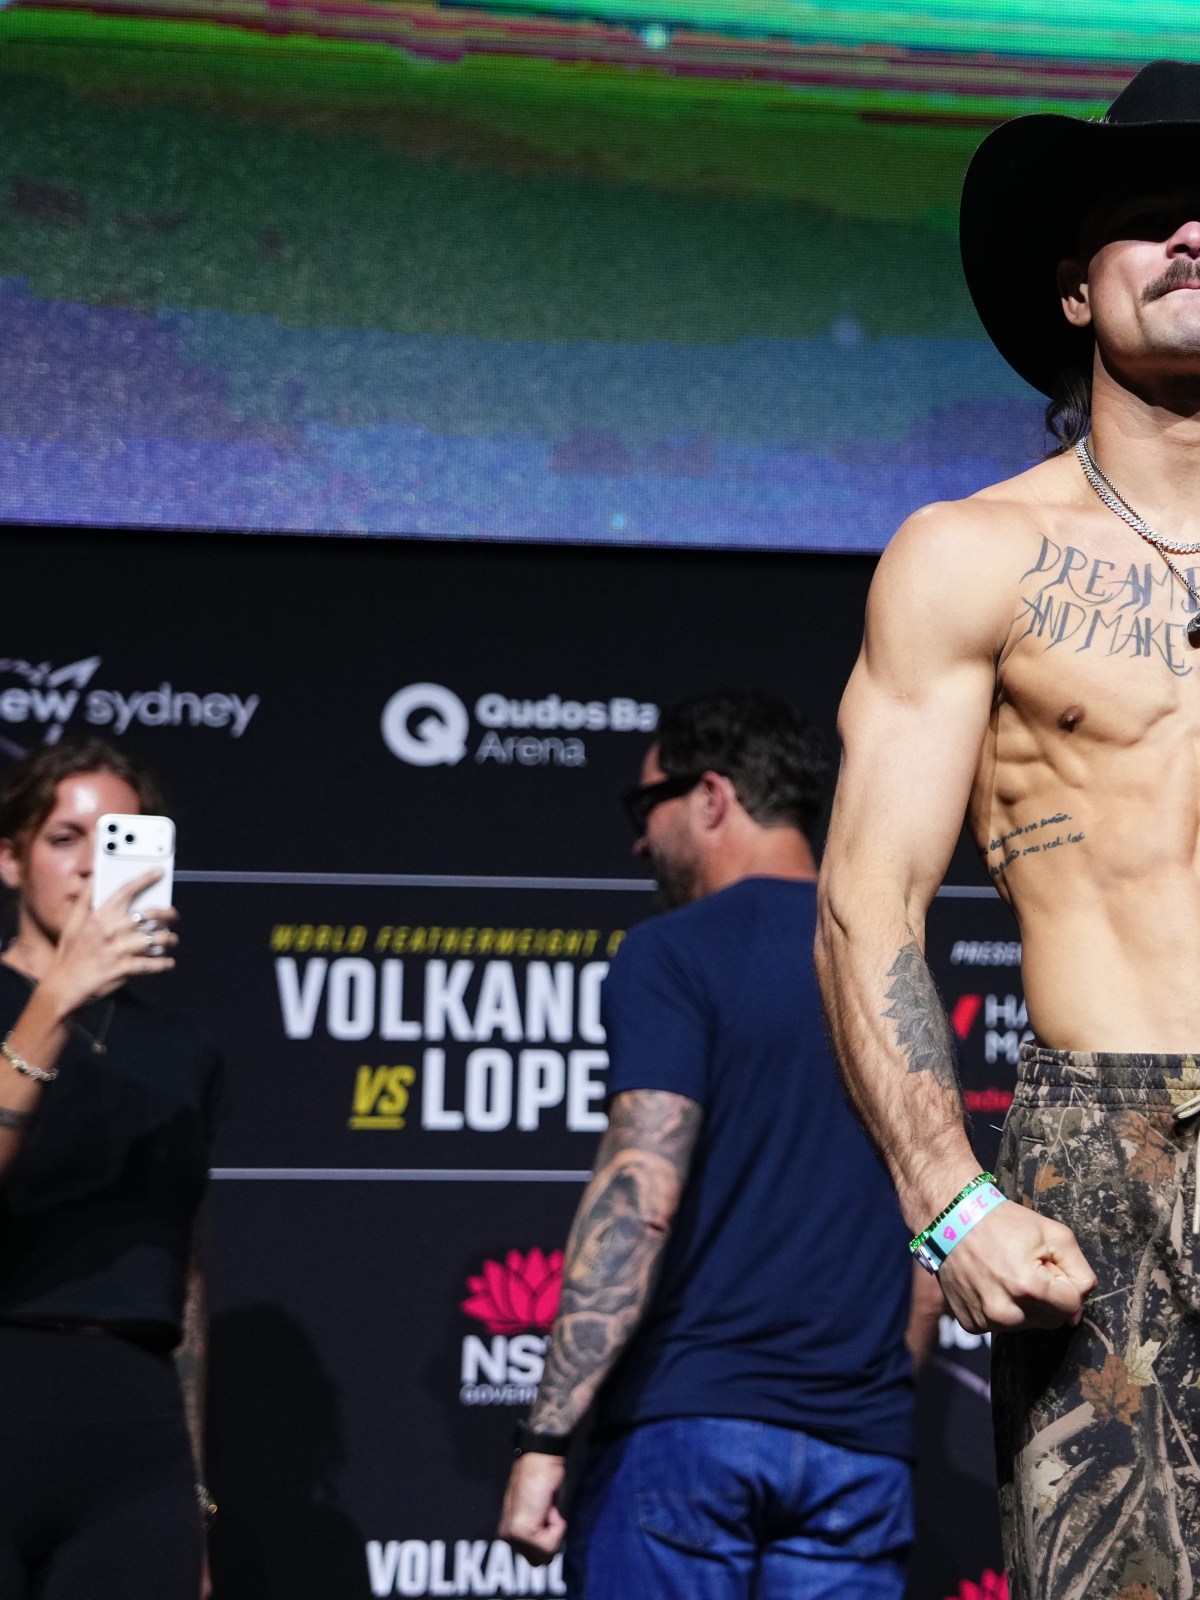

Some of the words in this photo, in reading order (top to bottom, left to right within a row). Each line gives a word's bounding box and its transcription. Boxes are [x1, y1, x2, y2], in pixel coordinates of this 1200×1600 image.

[1020, 532, 1174, 612] DREAM
[1011, 592, 1086, 652] AND
[1082, 611, 1194, 677] MAKE
[85, 681, 260, 738] sydney
[475, 693, 607, 730] Qudos
[474, 731, 588, 767] Arena
[271, 925, 367, 952] WORLD
[351, 1065, 416, 1116] VS
[421, 1047, 609, 1132] LOPE
[460, 1334, 551, 1385] NS
